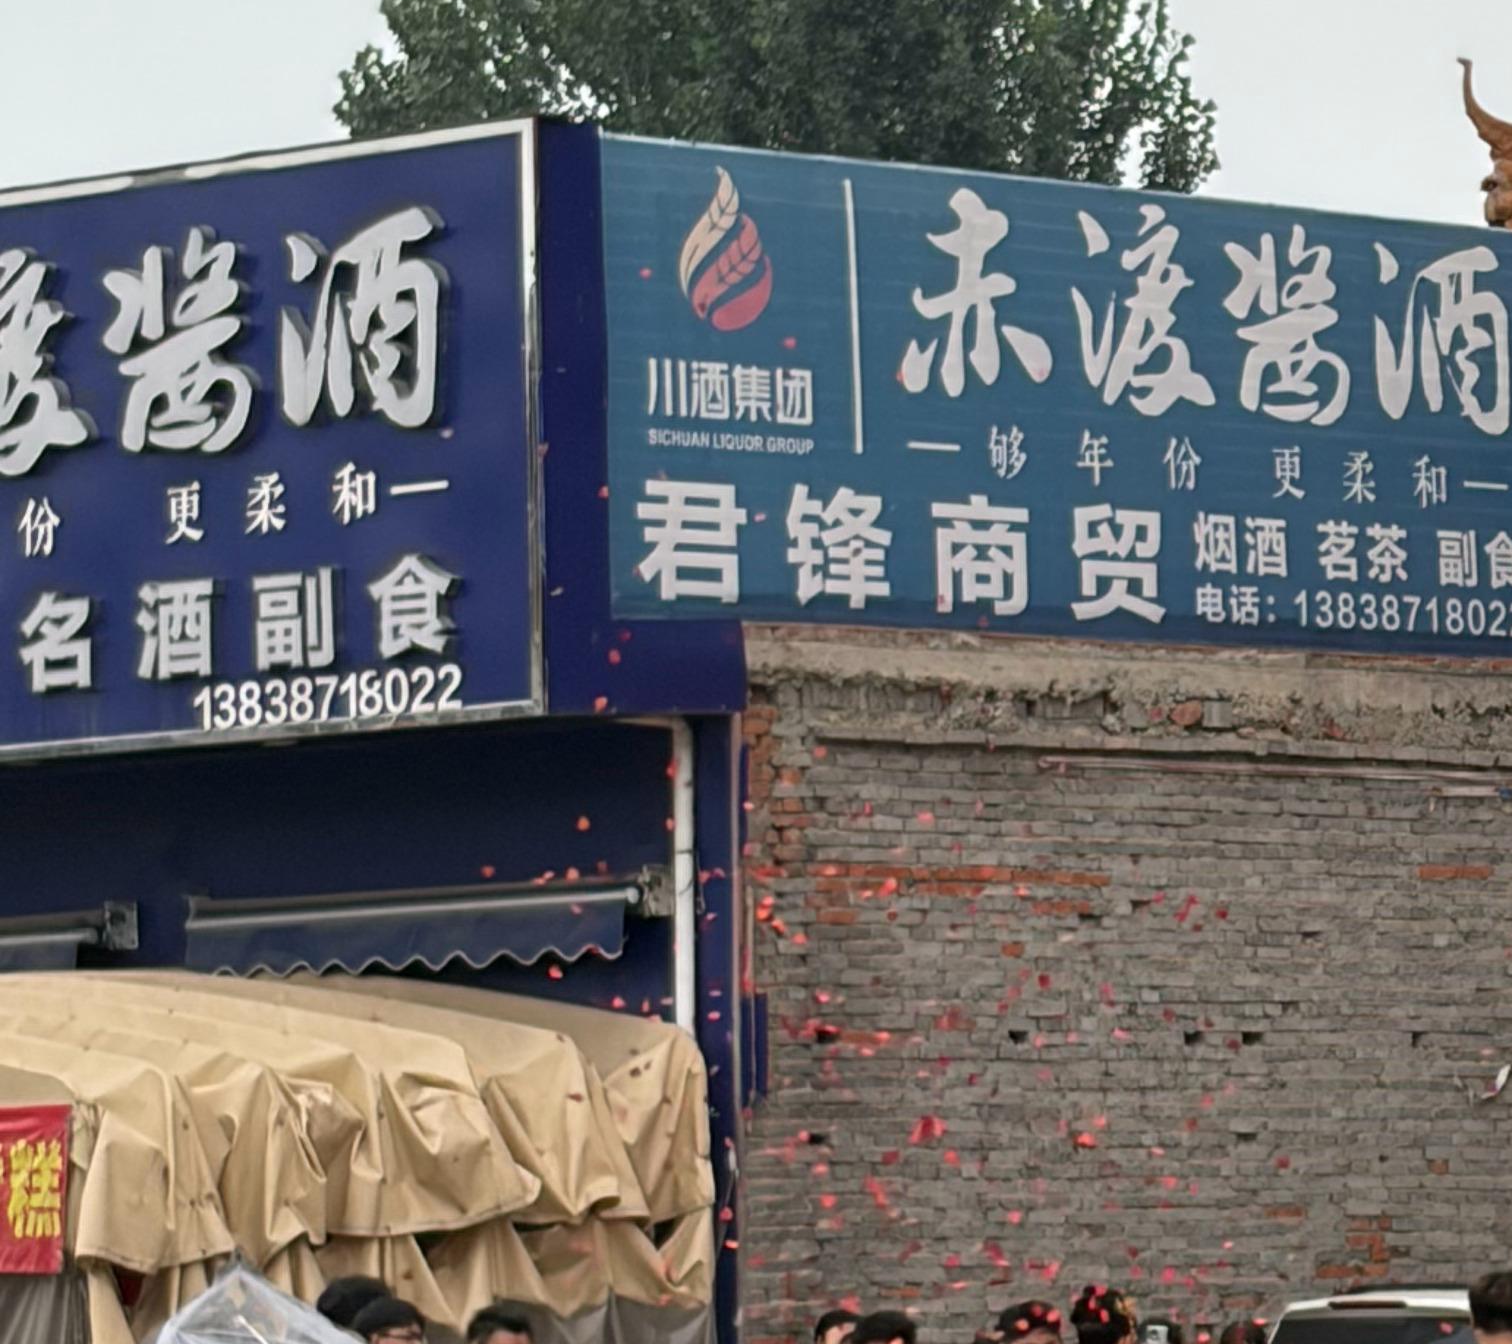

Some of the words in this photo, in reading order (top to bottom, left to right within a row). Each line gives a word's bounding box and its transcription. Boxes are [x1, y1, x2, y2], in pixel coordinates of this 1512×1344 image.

[901, 187, 1511, 436] 赤渡酱酒
[647, 357, 814, 426] 川酒集团
[648, 428, 710, 447] SICHUAN
[713, 432, 764, 451] LIQUOR
[766, 436, 815, 455] GROUP
[636, 479, 1167, 626] 君锋商贸
[1193, 510, 1289, 577] 烟酒
[1316, 519, 1409, 584] 茗茶
[18, 555, 459, 695] 名酒副食
[194, 664, 463, 731] 13838718022
